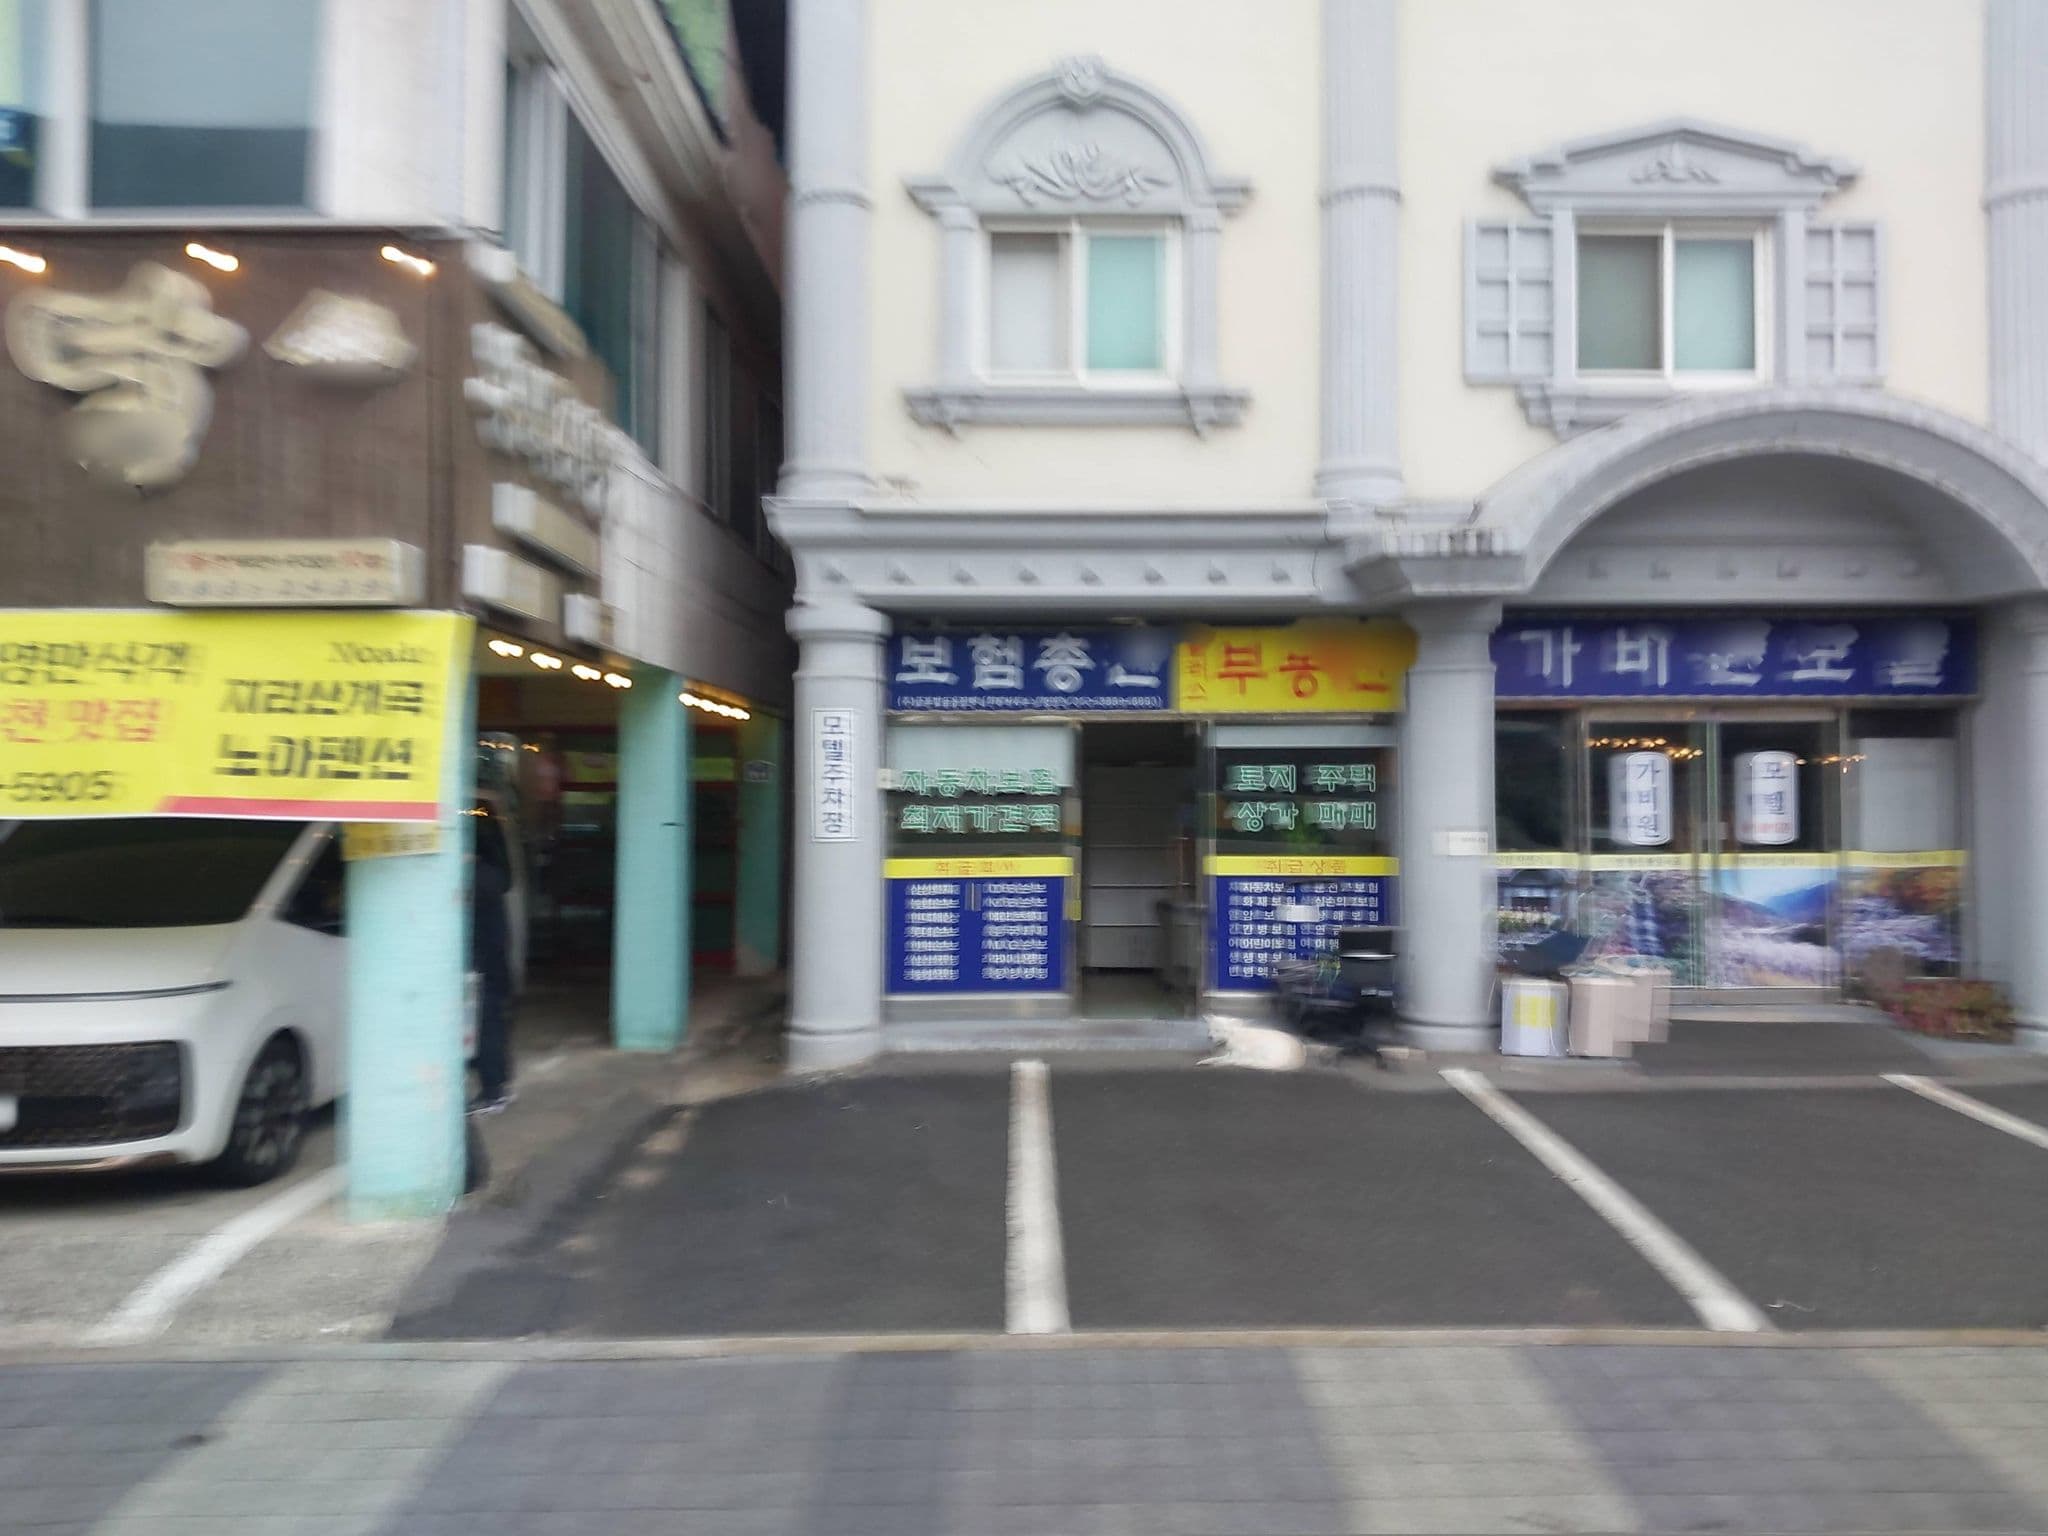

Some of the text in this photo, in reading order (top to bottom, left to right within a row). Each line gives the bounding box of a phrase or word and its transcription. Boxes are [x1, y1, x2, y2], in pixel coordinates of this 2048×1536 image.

[896, 633, 1161, 694] 보험총
[217, 678, 425, 716] 지리산계곡
[207, 734, 413, 780] 노아펜션
[1233, 764, 1376, 792] 토지 주택
[1236, 802, 1376, 832] 상가 매매
